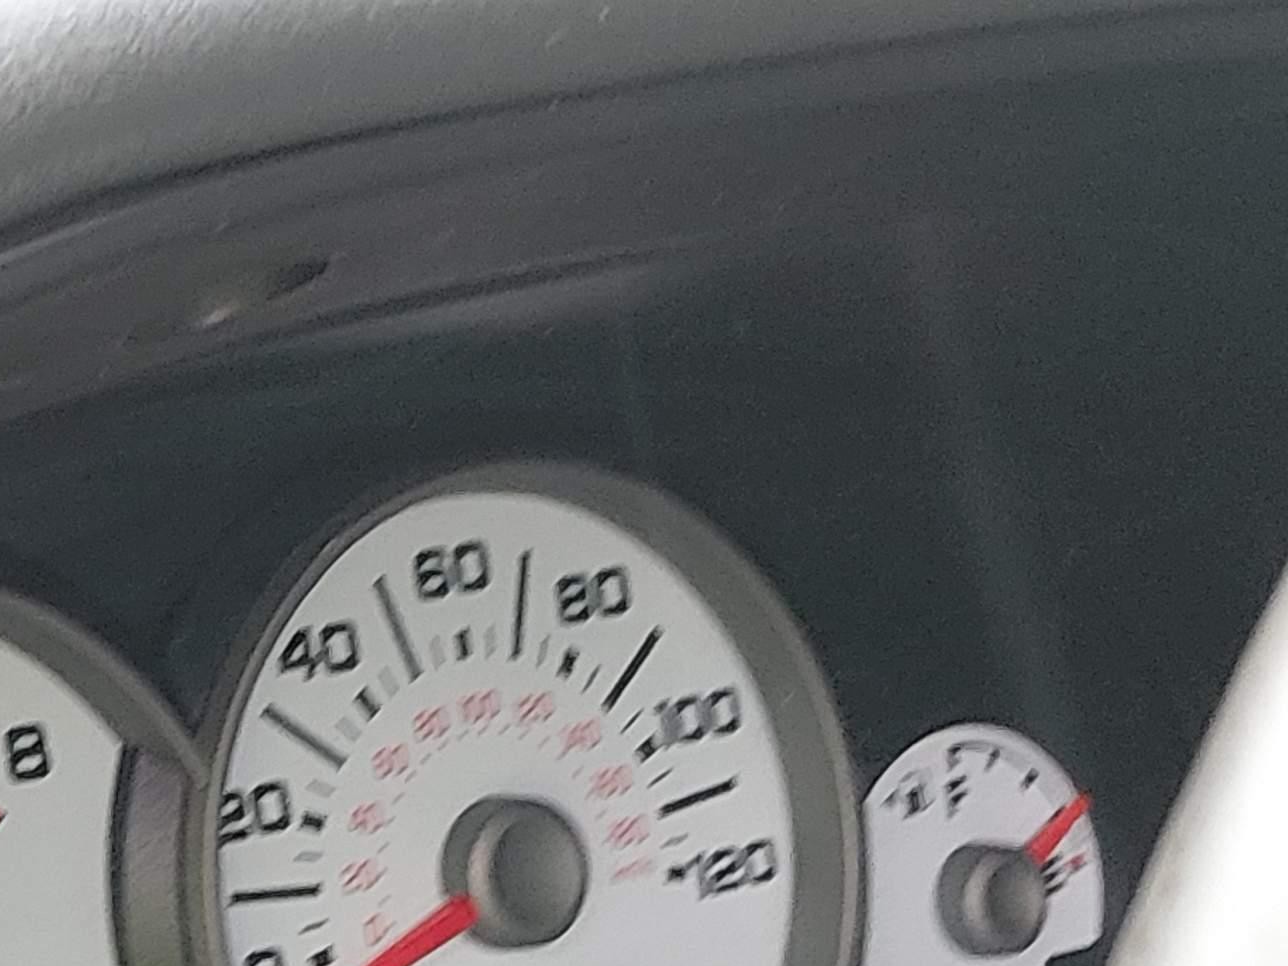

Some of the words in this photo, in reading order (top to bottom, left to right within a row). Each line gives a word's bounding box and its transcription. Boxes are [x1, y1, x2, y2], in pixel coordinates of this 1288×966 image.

[413, 540, 490, 598] 60
[556, 566, 632, 622] 80
[279, 621, 359, 680] 40
[652, 686, 742, 749] 100
[6, 724, 51, 780] 8
[219, 781, 291, 844] 20
[684, 839, 778, 902] 120
